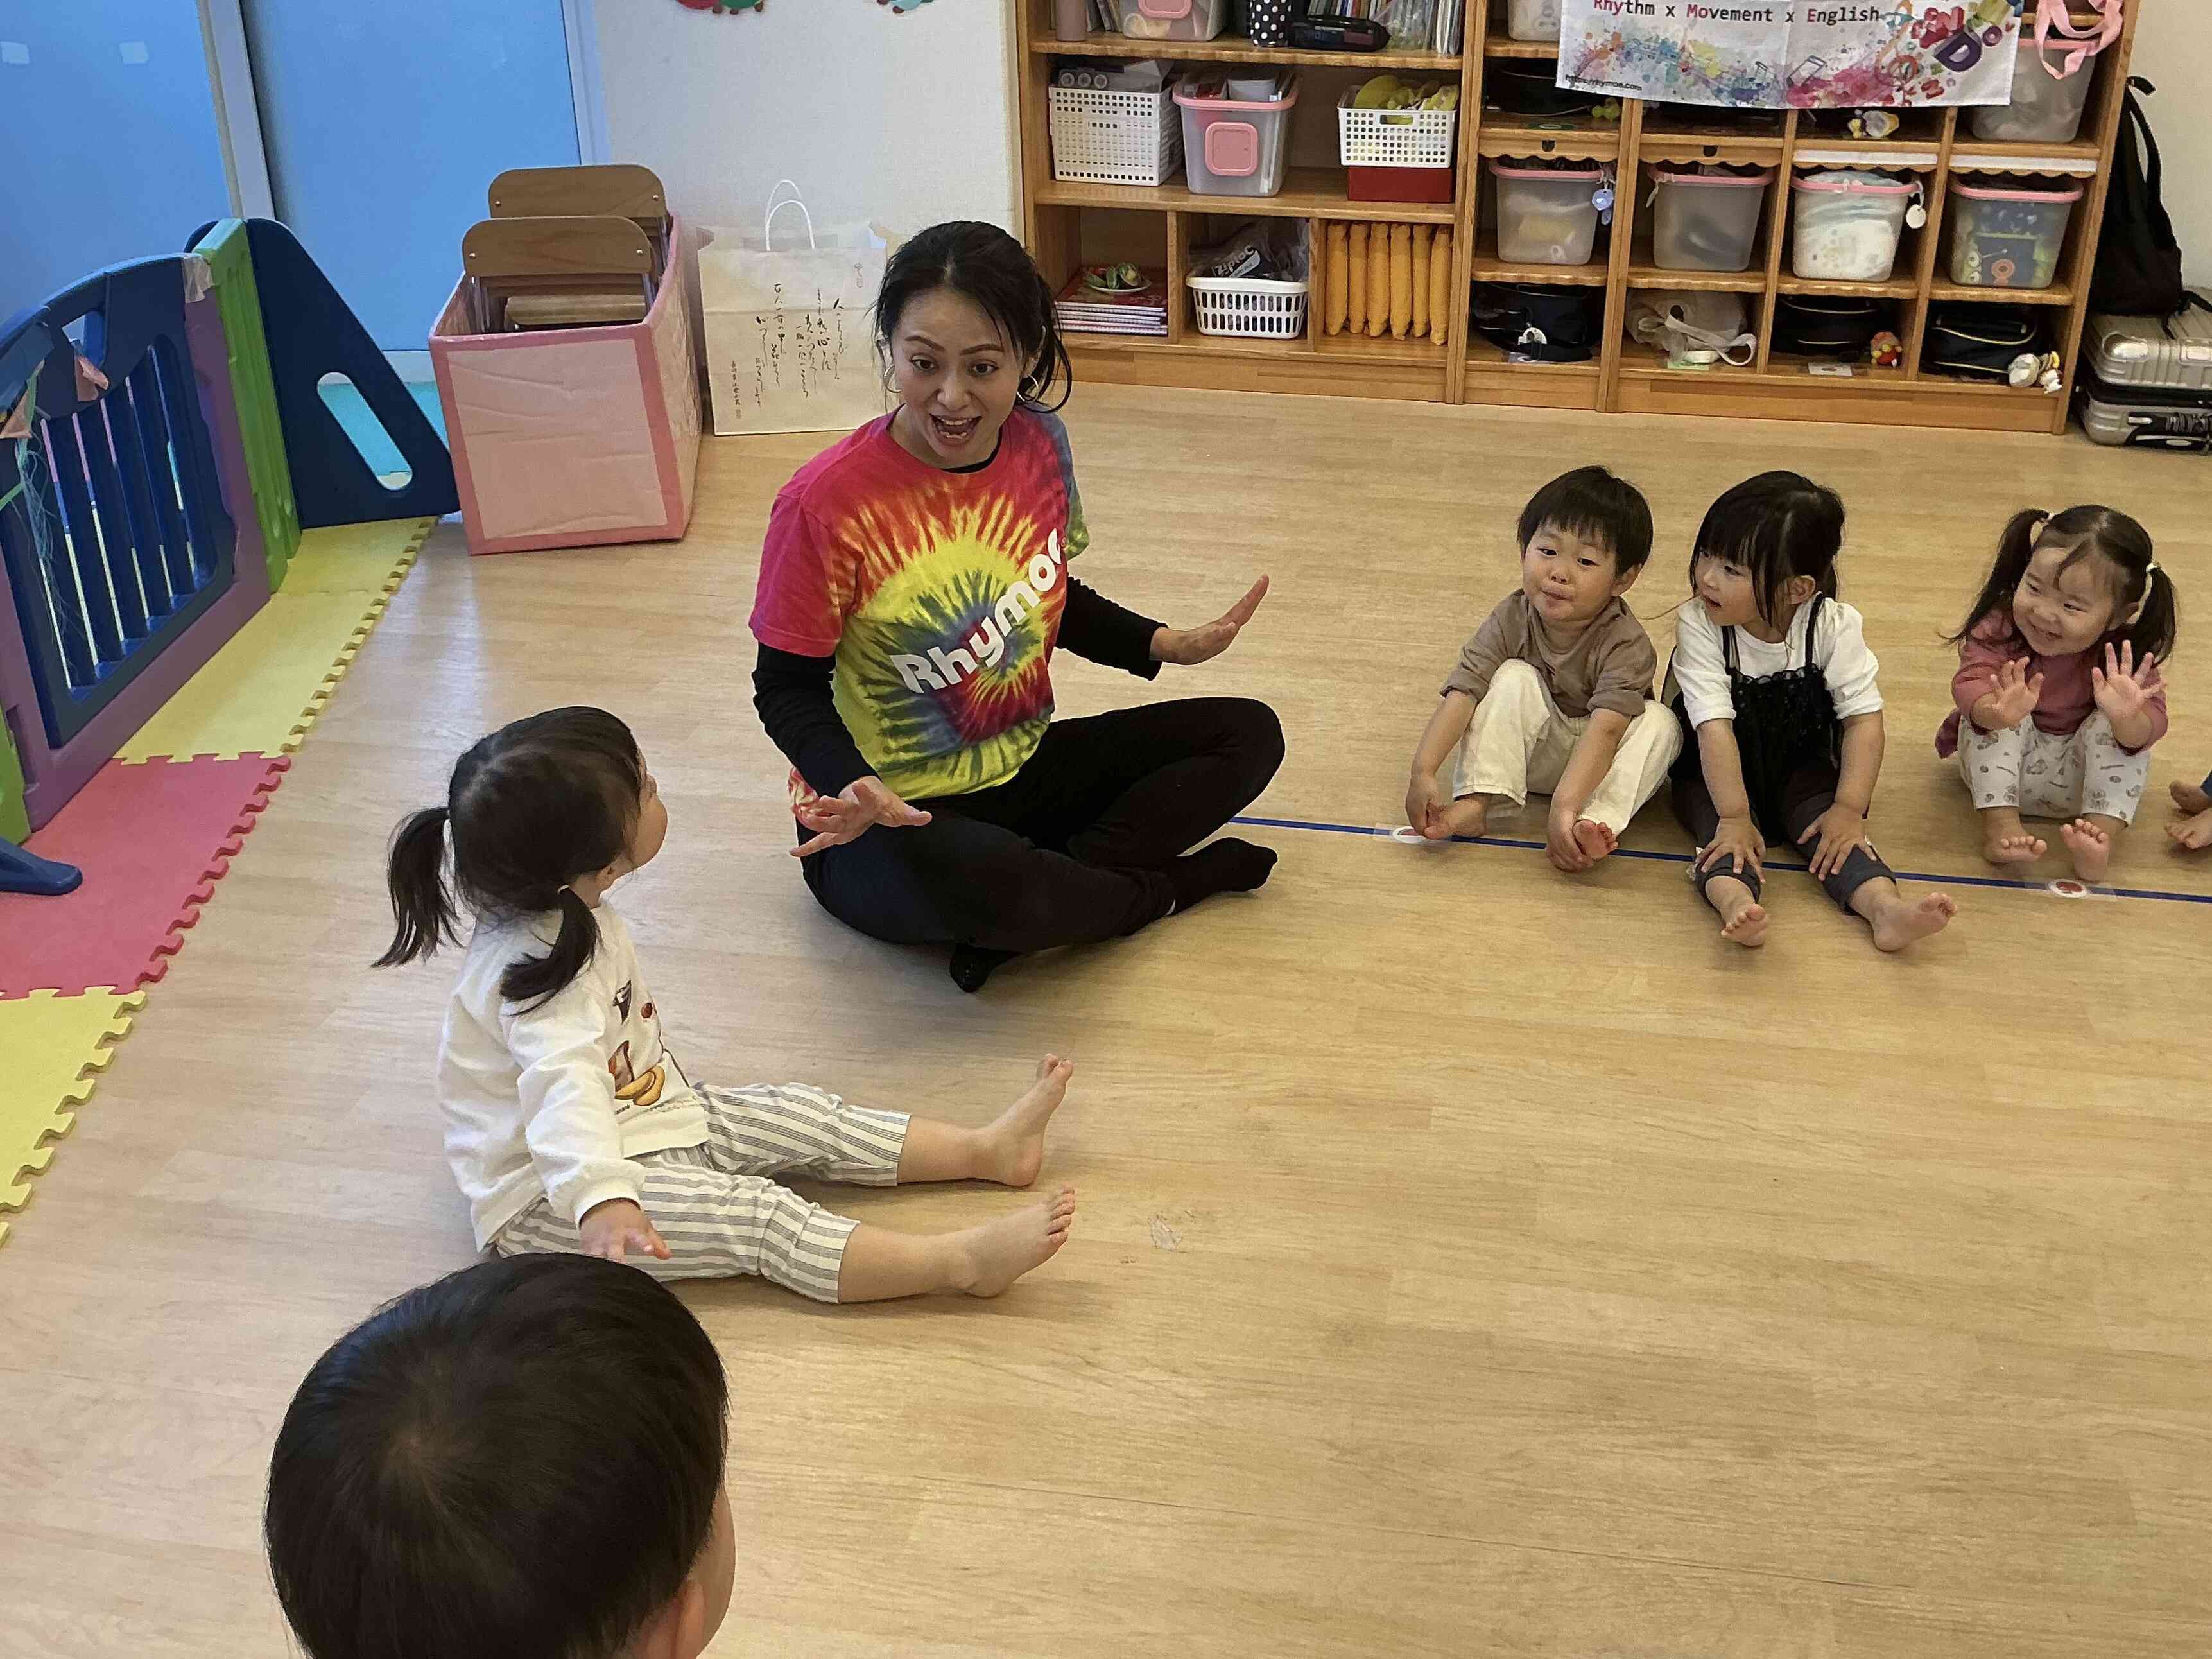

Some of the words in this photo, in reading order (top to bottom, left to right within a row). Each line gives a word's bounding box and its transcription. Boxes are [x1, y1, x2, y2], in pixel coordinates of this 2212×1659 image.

[1594, 0, 1655, 16] Rhythm
[1666, 5, 1676, 18] x
[1686, 4, 1773, 22] Movement
[1785, 11, 1795, 23] x
[1807, 6, 1880, 26] English
